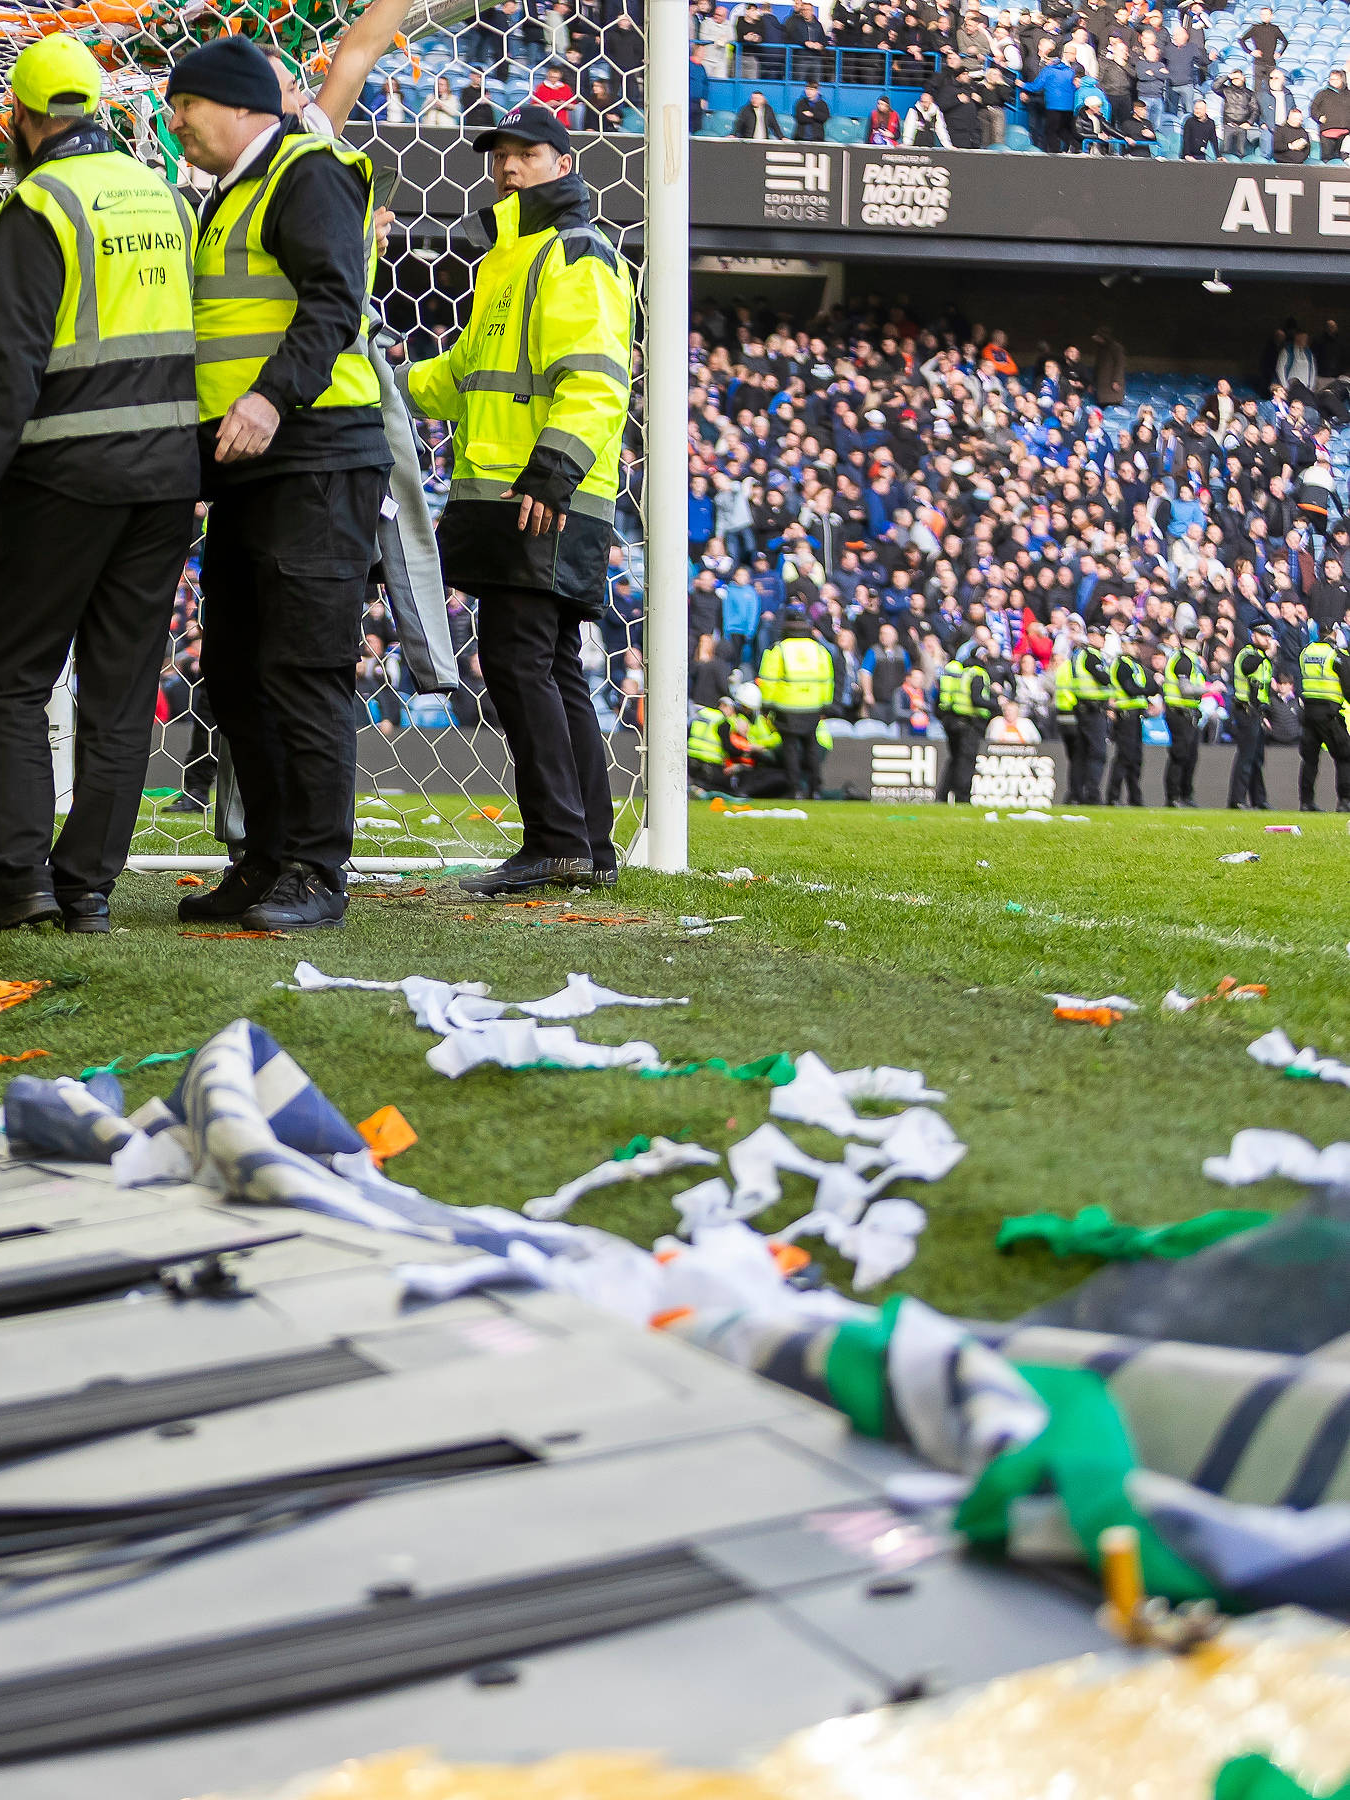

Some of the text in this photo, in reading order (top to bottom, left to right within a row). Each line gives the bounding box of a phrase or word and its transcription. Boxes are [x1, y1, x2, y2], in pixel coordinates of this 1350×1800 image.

[863, 164, 950, 187] PARK'S
[764, 193, 831, 206] EDMISTON
[861, 184, 952, 208] MOTOR
[1220, 177, 1305, 235] AT
[764, 205, 830, 221] HOUSE
[860, 203, 949, 229] GROUP
[487, 323, 505, 336] 278
[970, 775, 1056, 799] MOTOR
